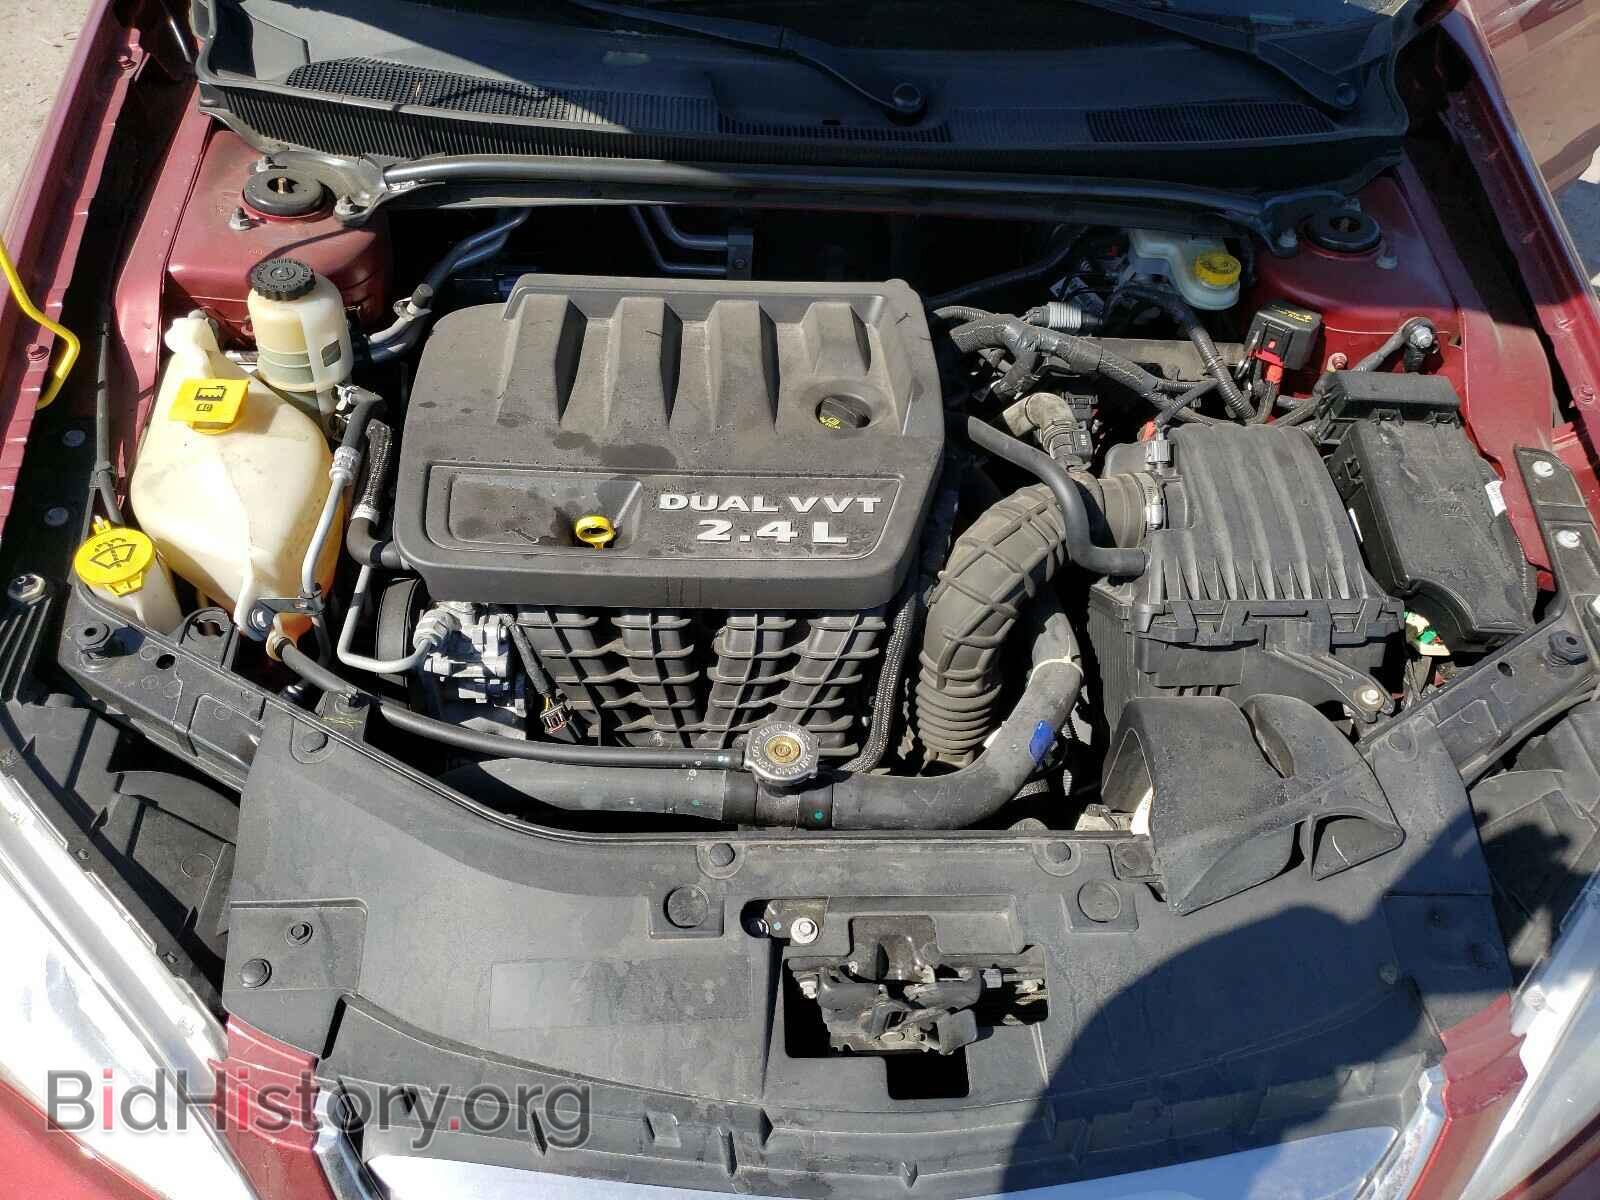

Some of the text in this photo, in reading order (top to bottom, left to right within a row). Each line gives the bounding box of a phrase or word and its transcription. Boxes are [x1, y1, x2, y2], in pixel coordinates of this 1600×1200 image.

[659, 493, 882, 513] DUAL VVT
[696, 519, 848, 544] 2.4 L
